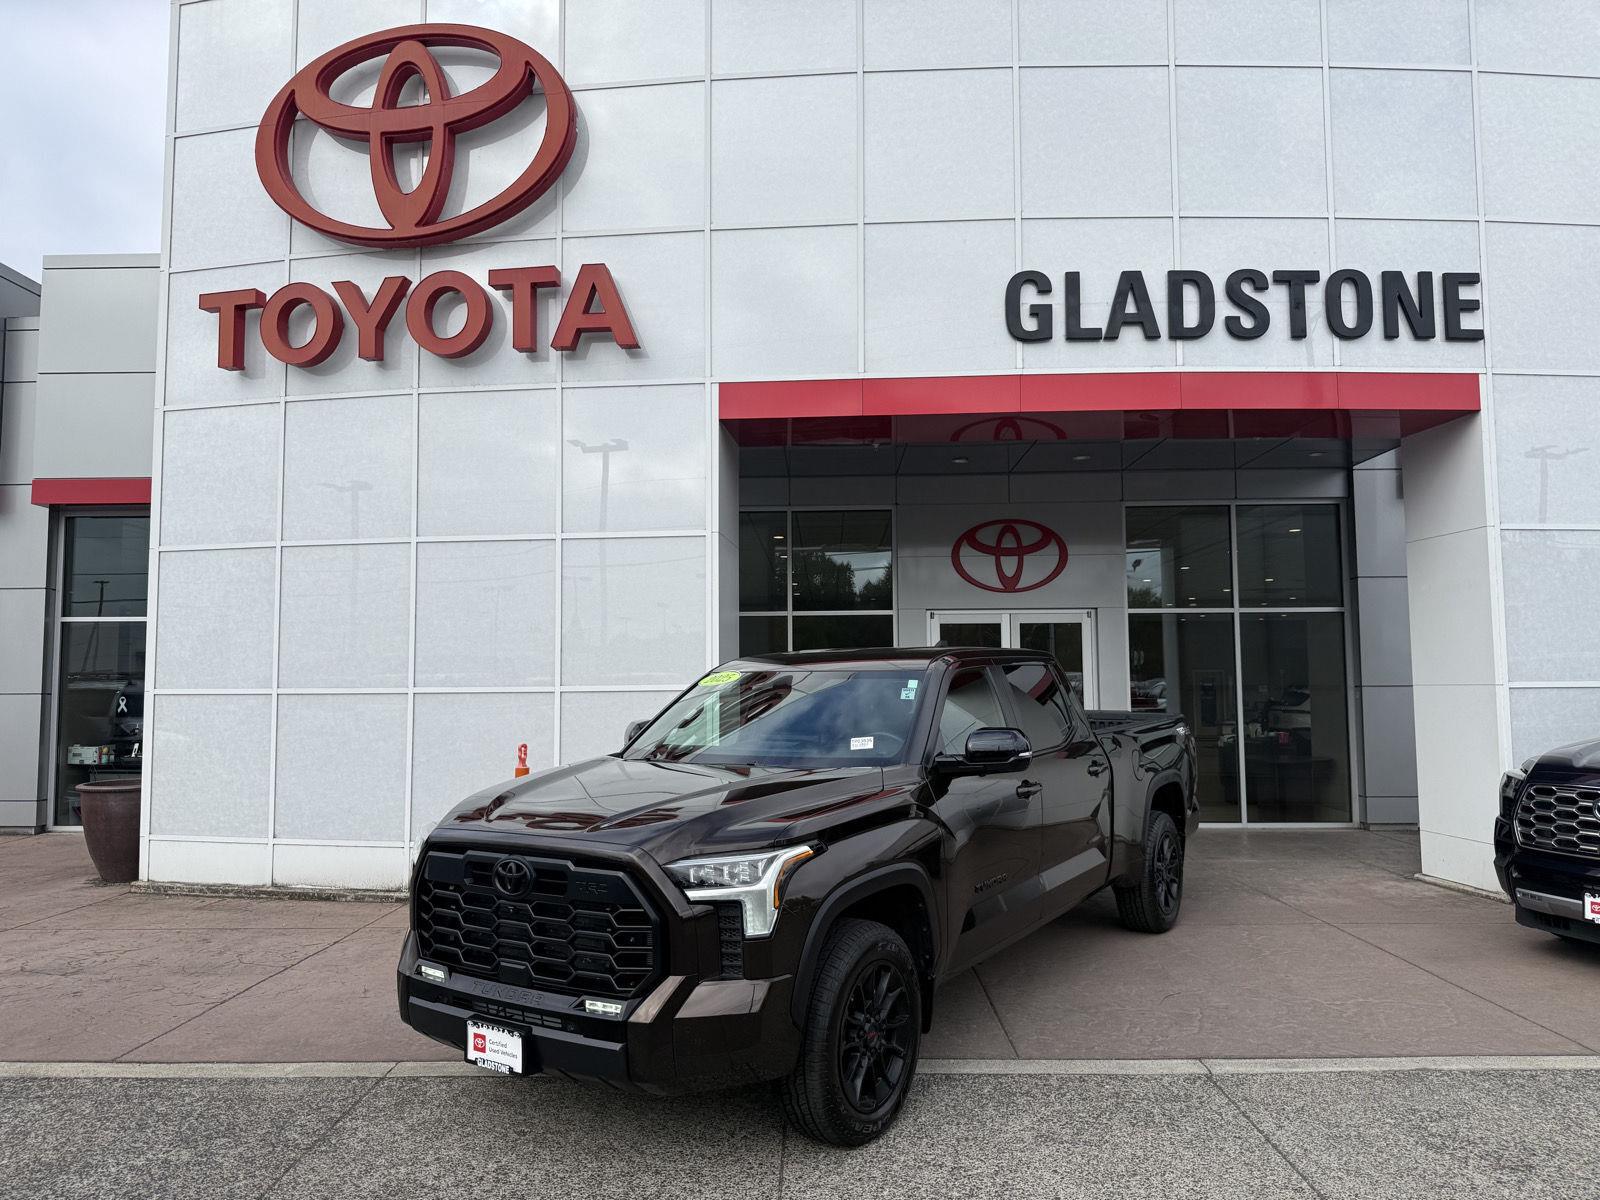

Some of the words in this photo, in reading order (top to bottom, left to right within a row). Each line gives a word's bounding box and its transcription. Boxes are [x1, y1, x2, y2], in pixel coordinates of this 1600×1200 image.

[199, 263, 640, 371] TOYOTA
[1004, 268, 1485, 342] GLADSTONE
[477, 1057, 510, 1075] GLADSTONE
[488, 1038, 508, 1049] Certified
